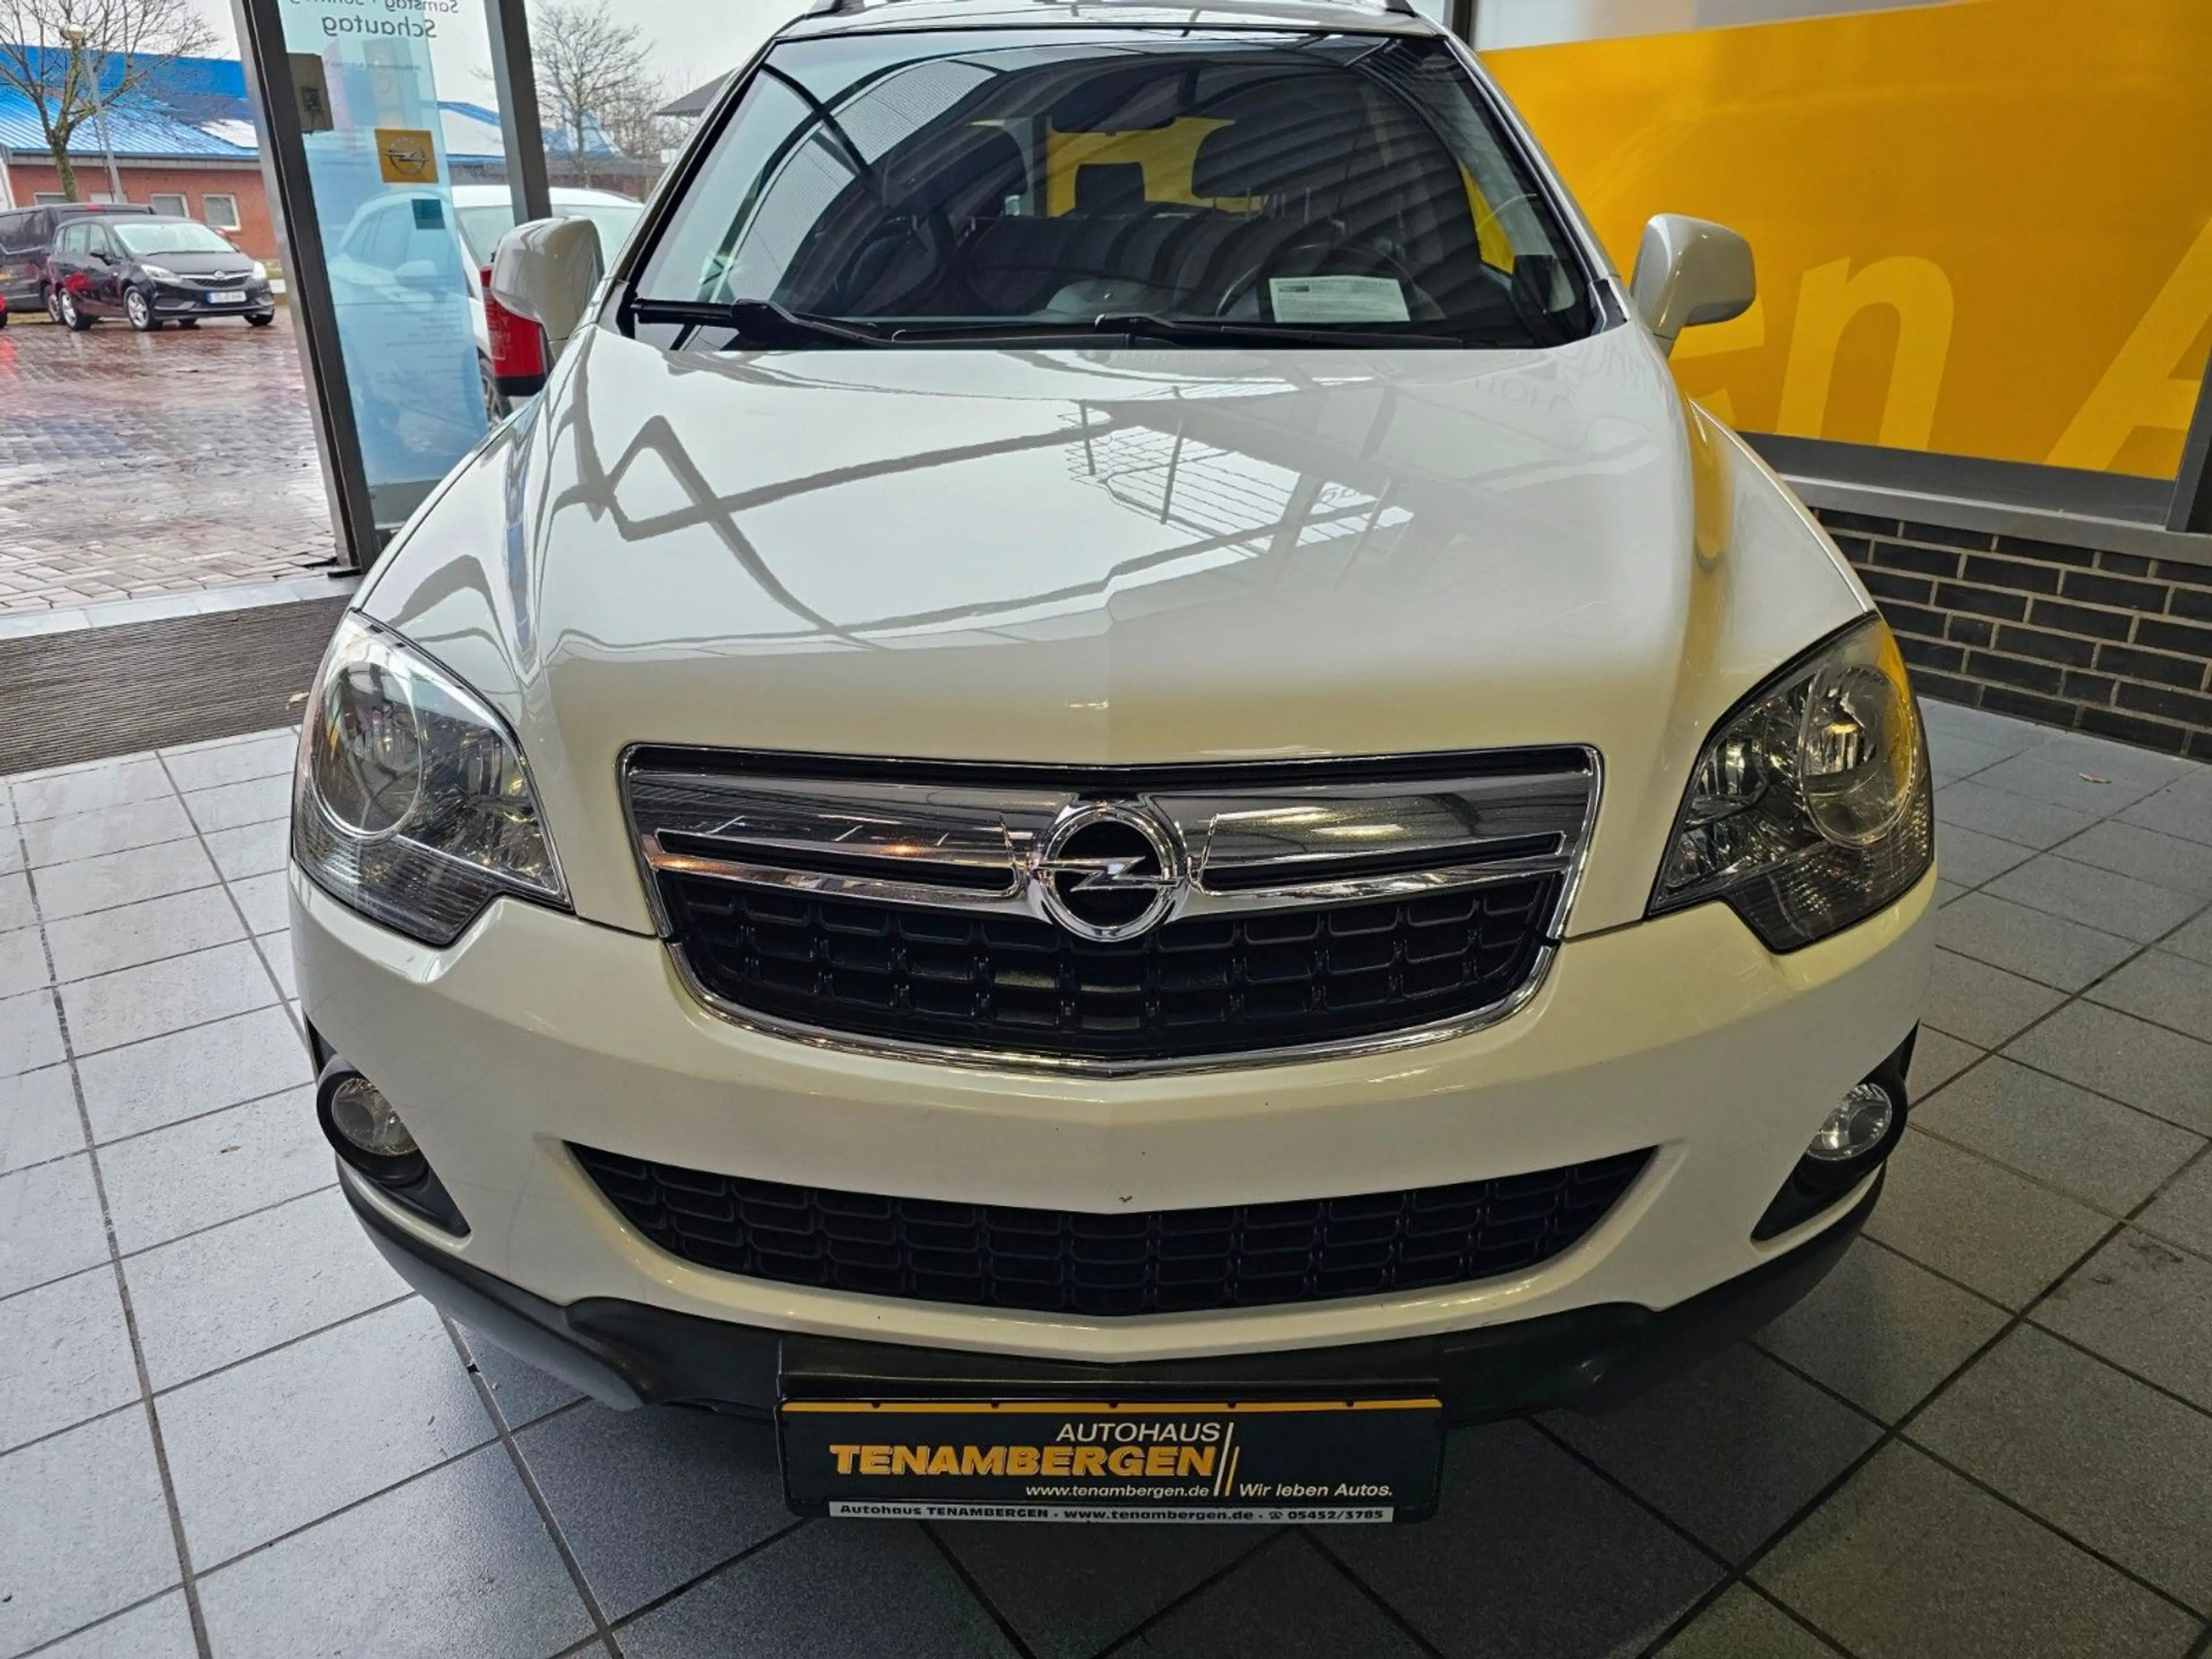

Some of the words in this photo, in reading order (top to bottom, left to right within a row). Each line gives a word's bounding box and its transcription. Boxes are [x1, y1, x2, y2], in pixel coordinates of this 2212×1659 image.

[1055, 1422, 1221, 1442] AUTOHAUS
[829, 1445, 1217, 1476] TENAMBERGEN
[1025, 1485, 1210, 1498] www.tenambergen.de
[1239, 1483, 1271, 1497] Wir
[1275, 1483, 1329, 1497] leben
[1334, 1483, 1393, 1497] Autos.
[840, 1505, 922, 1515] Autohaus
[926, 1506, 1048, 1518] TENAMBERGEN
[1064, 1509, 1254, 1521] www.tenambergen.de
[1287, 1510, 1384, 1520] 05452/3785
